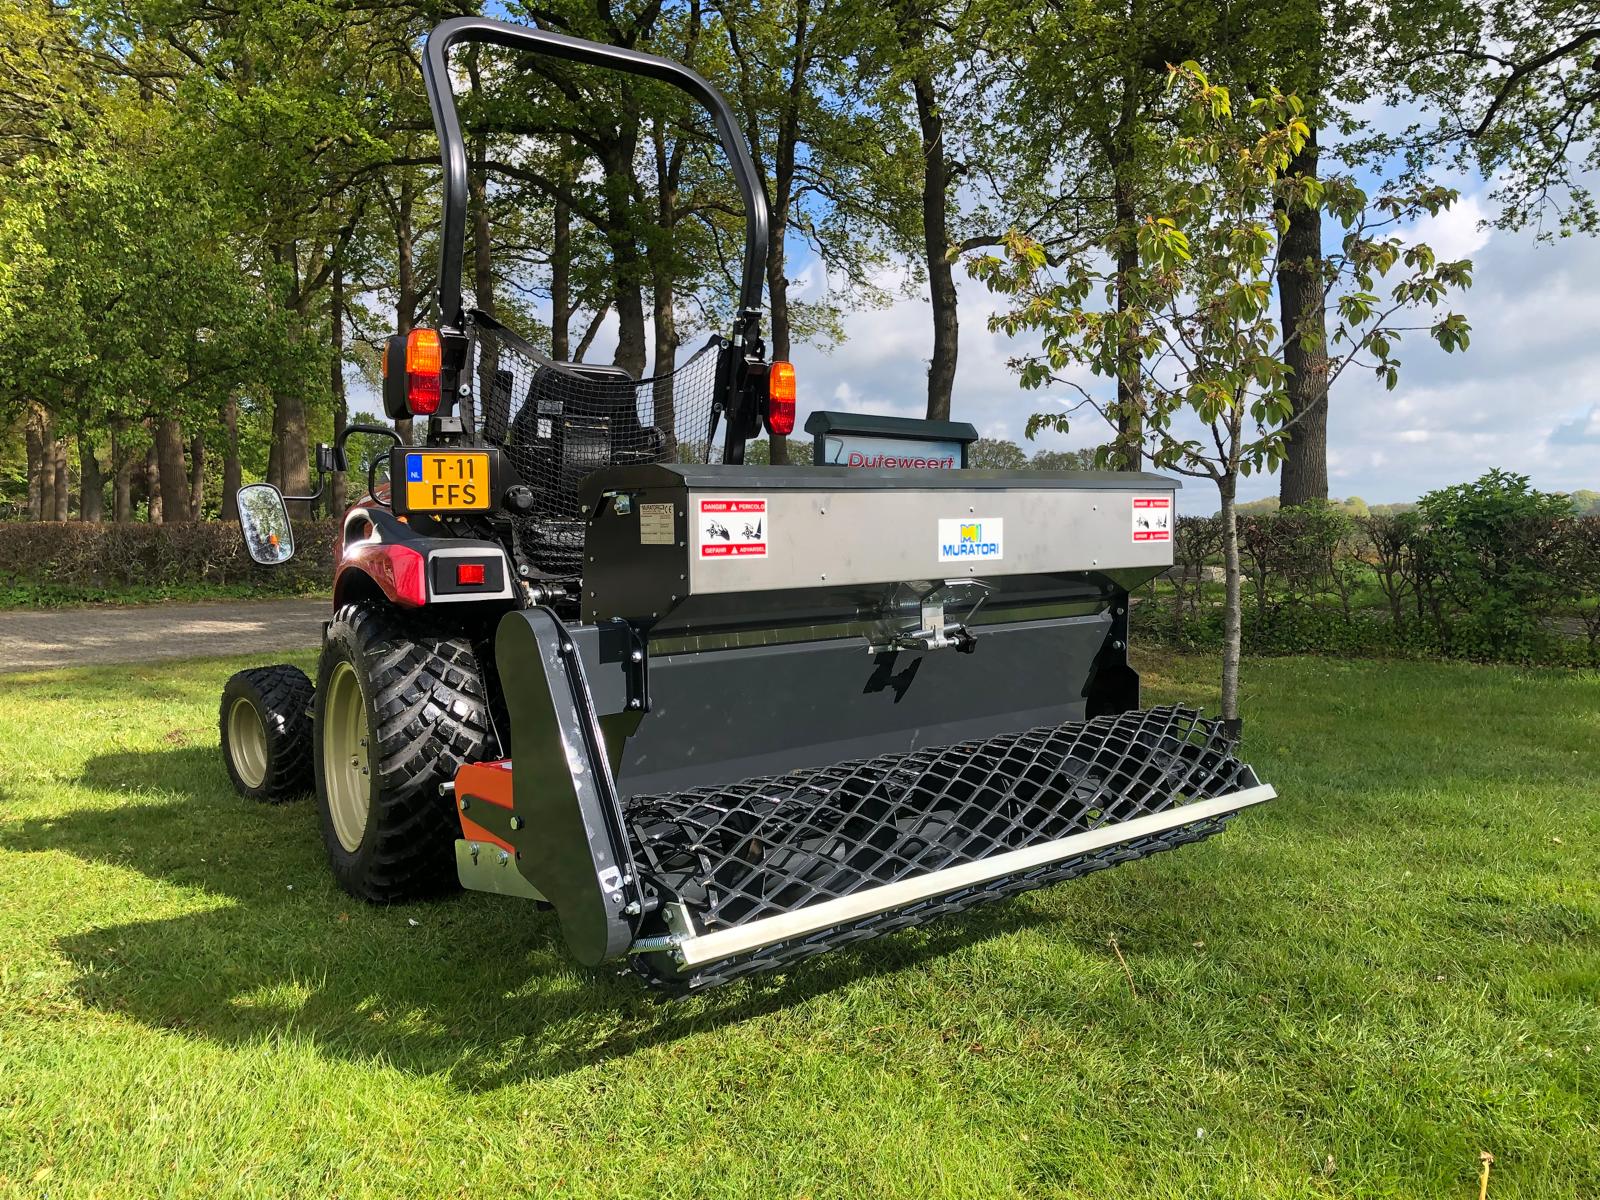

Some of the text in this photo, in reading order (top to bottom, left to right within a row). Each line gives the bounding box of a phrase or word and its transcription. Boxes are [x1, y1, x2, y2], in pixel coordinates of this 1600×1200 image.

[433, 458, 474, 480] T-11
[848, 452, 955, 469] Duteweert
[410, 471, 420, 479] NL
[432, 484, 476, 506] FFS
[943, 543, 999, 557] MURATORI
